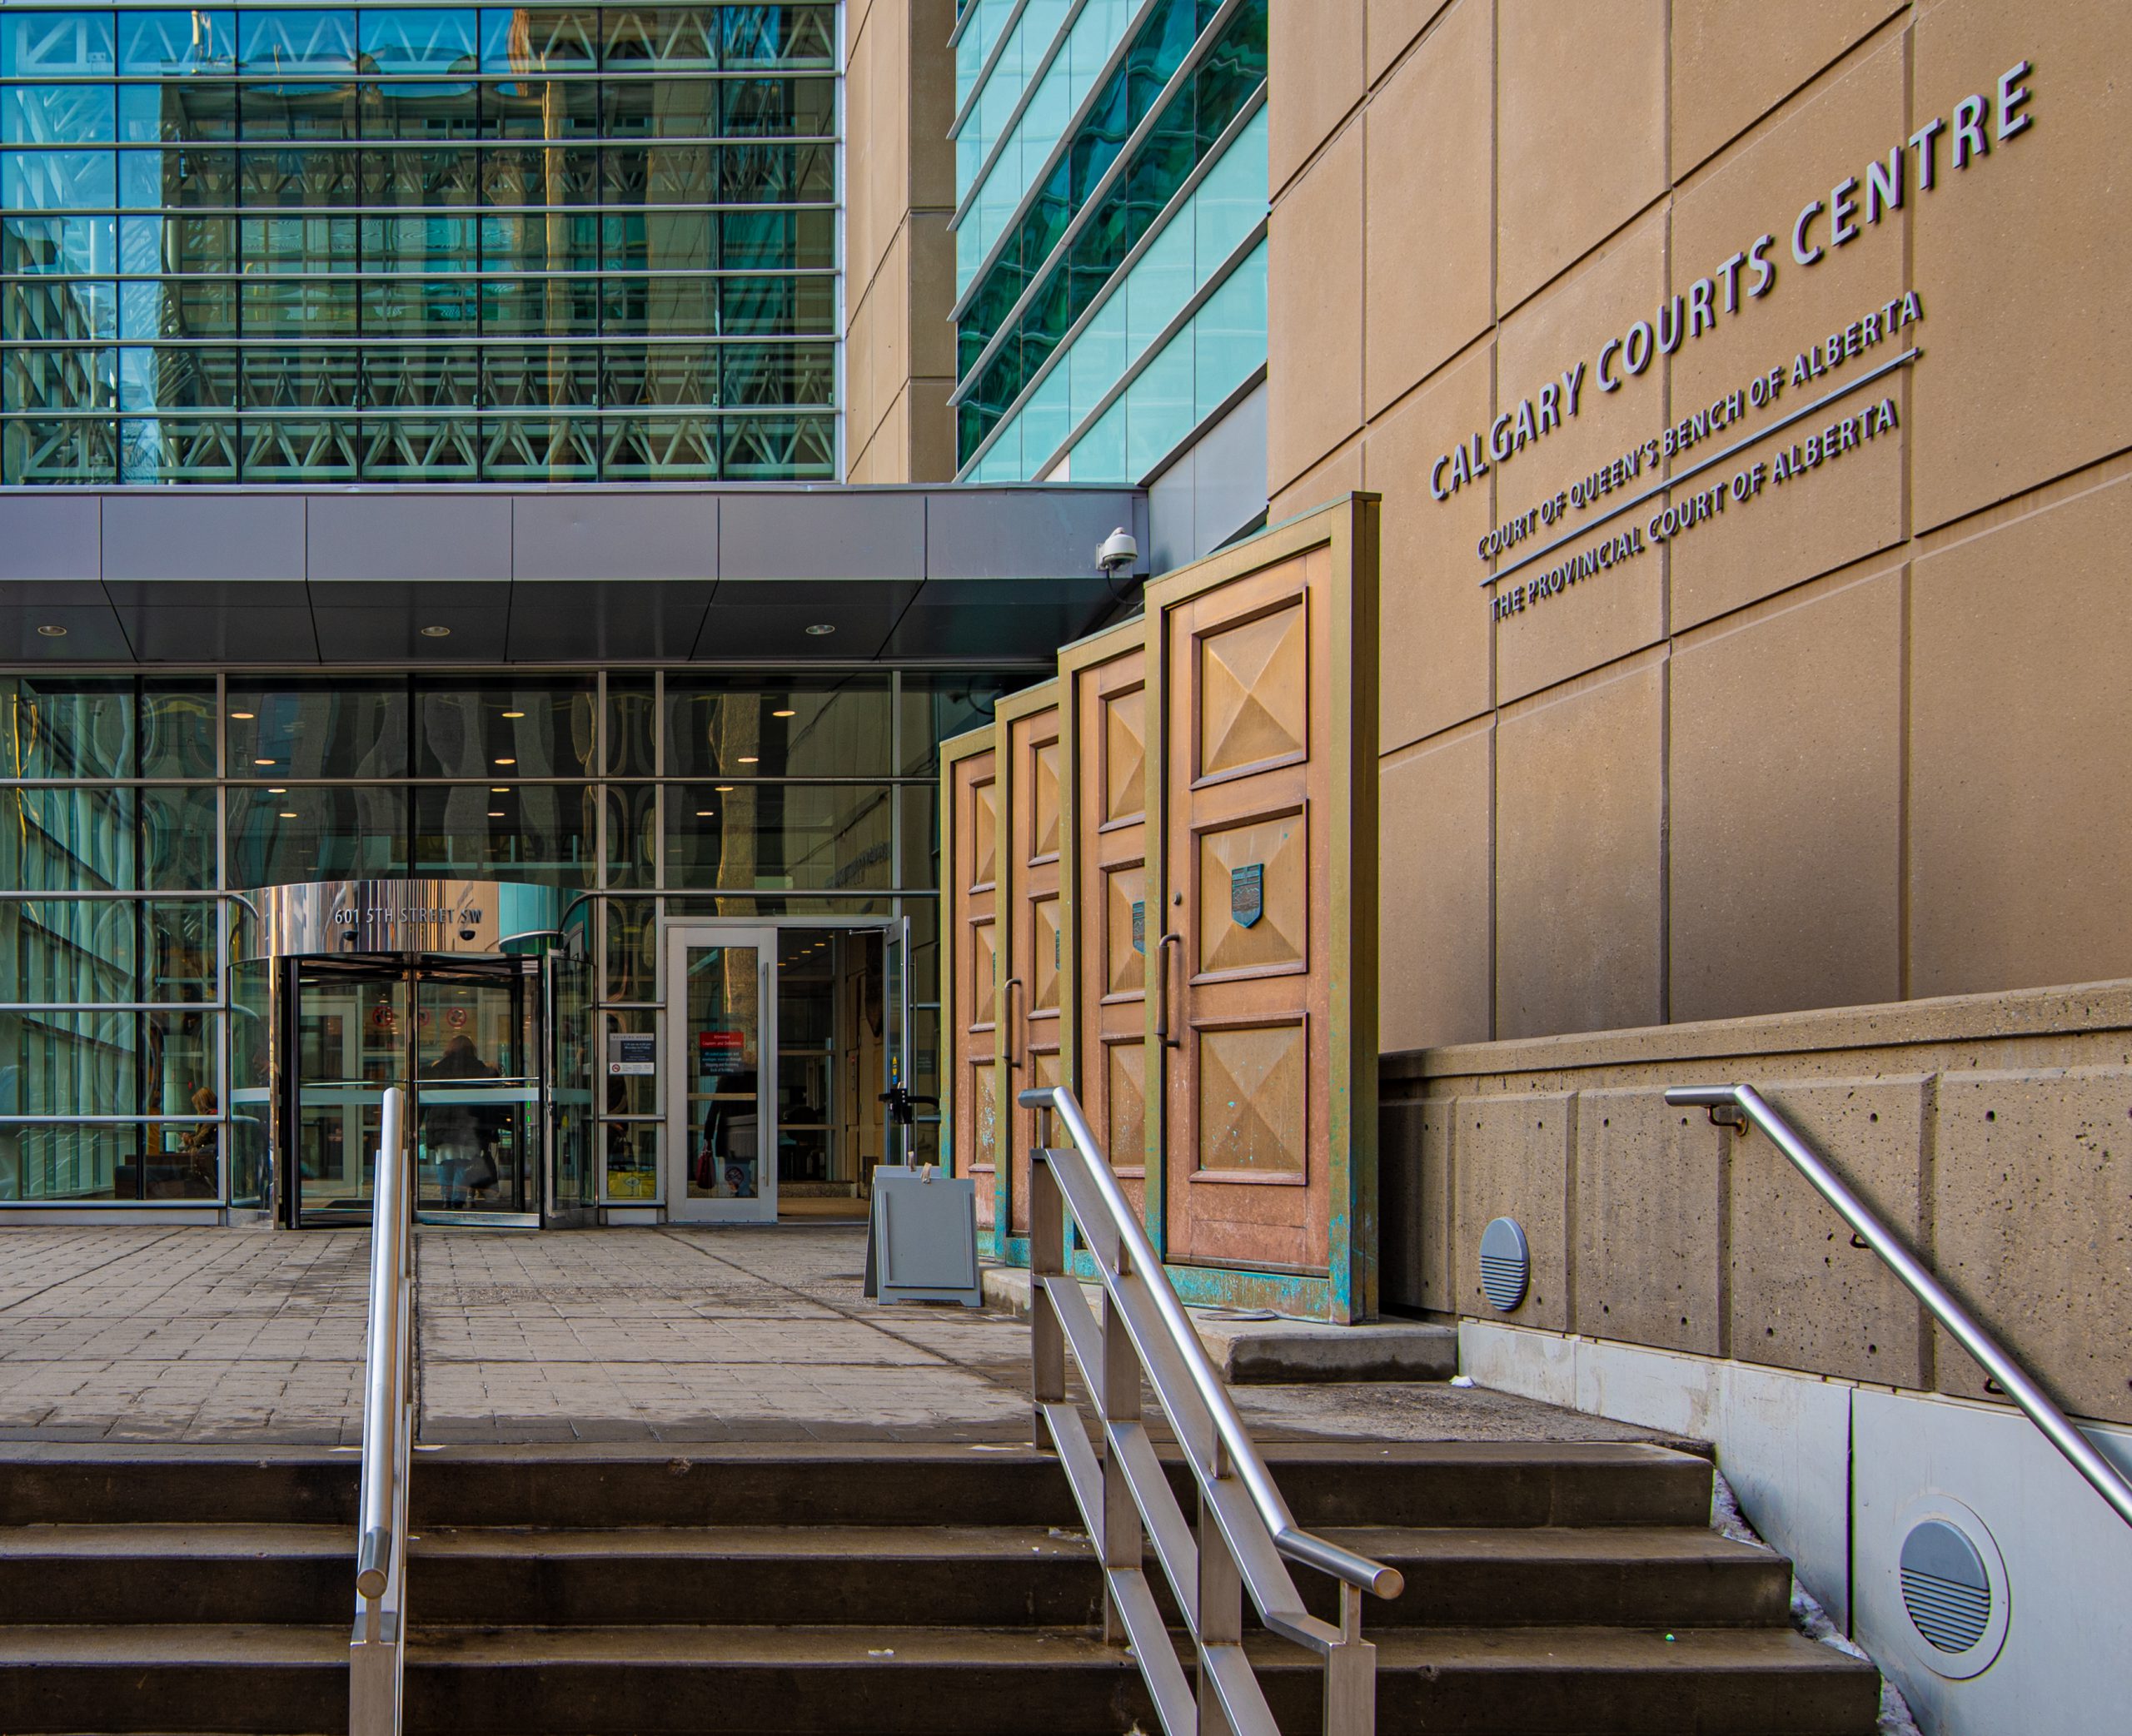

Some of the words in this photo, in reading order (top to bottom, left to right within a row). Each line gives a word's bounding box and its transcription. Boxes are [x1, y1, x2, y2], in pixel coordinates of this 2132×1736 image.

[1429, 361, 1584, 500] CALGARY
[1596, 234, 1774, 392] COURTS
[1791, 60, 2031, 266] CENTRE
[1477, 508, 1536, 560] COURT
[1540, 490, 1566, 525] OF
[1570, 439, 1659, 508] QUEEN'S
[1662, 389, 1744, 457] BENCH
[1750, 366, 1782, 407] OF
[1791, 291, 1923, 386] ALBERTA
[1490, 585, 1524, 622] THE
[1527, 527, 1645, 604] PROVINCIAL
[1646, 482, 1726, 542] COURT
[1731, 462, 1765, 501] OF
[1771, 398, 1899, 484] ALBERTA
[335, 908, 359, 924] 601
[366, 908, 394, 923] 5TH
[401, 908, 455, 924] STREET
[460, 908, 483, 924] SW
